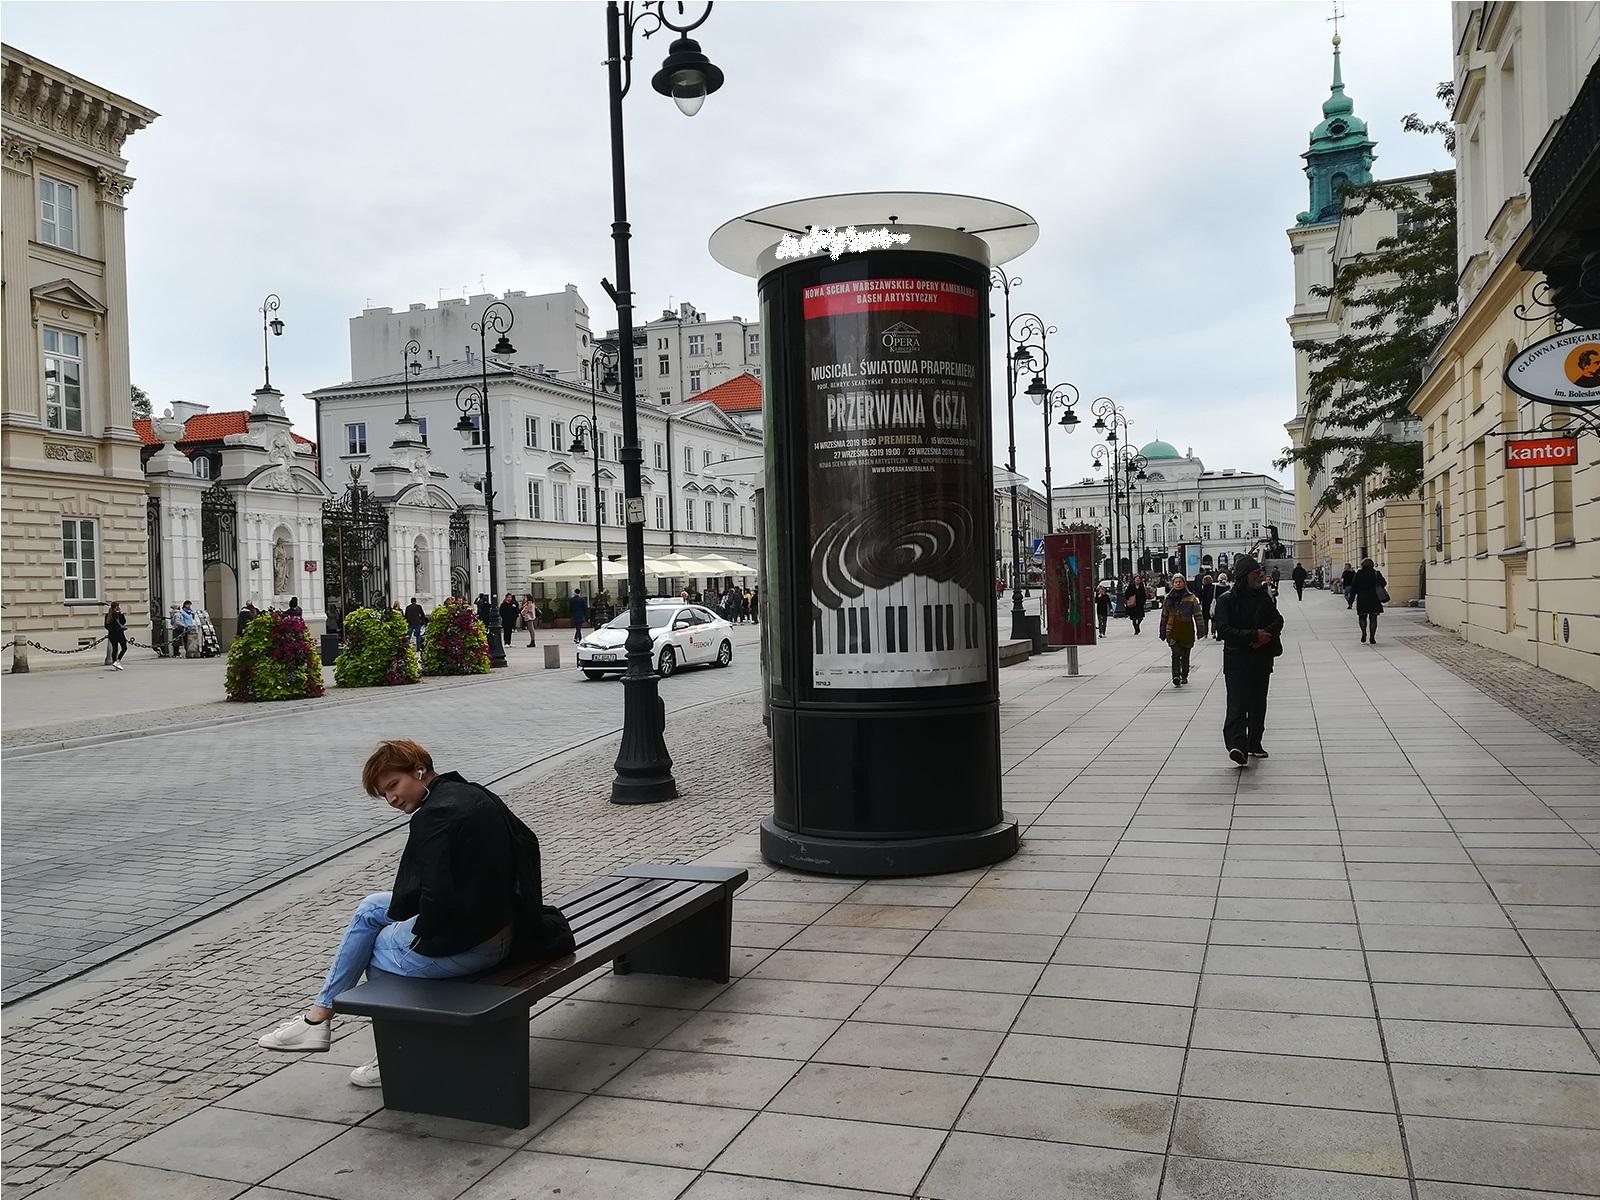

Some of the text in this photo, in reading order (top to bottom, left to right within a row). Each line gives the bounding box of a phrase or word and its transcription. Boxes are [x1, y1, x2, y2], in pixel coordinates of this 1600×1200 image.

[805, 288, 824, 299] NOWA
[826, 283, 850, 295] SCENA
[853, 280, 914, 292] WARSZAWSKIEJ
[916, 280, 939, 291] OPERY
[857, 292, 938, 304] BASEN ARTYSTYCZNY
[1517, 333, 1600, 373] GŁÓWNA KSIĘGAR
[811, 359, 976, 381] MUSICAL. ŚWIATOWA PRAPREMIERA
[1554, 388, 1566, 397] im.
[827, 388, 968, 432] PRZERWANA CISZA
[846, 439, 860, 448] 2019
[878, 435, 923, 445] PREMIERA
[833, 451, 841, 459] 27
[869, 448, 884, 457] 2019
[1508, 444, 1576, 460] kantor
